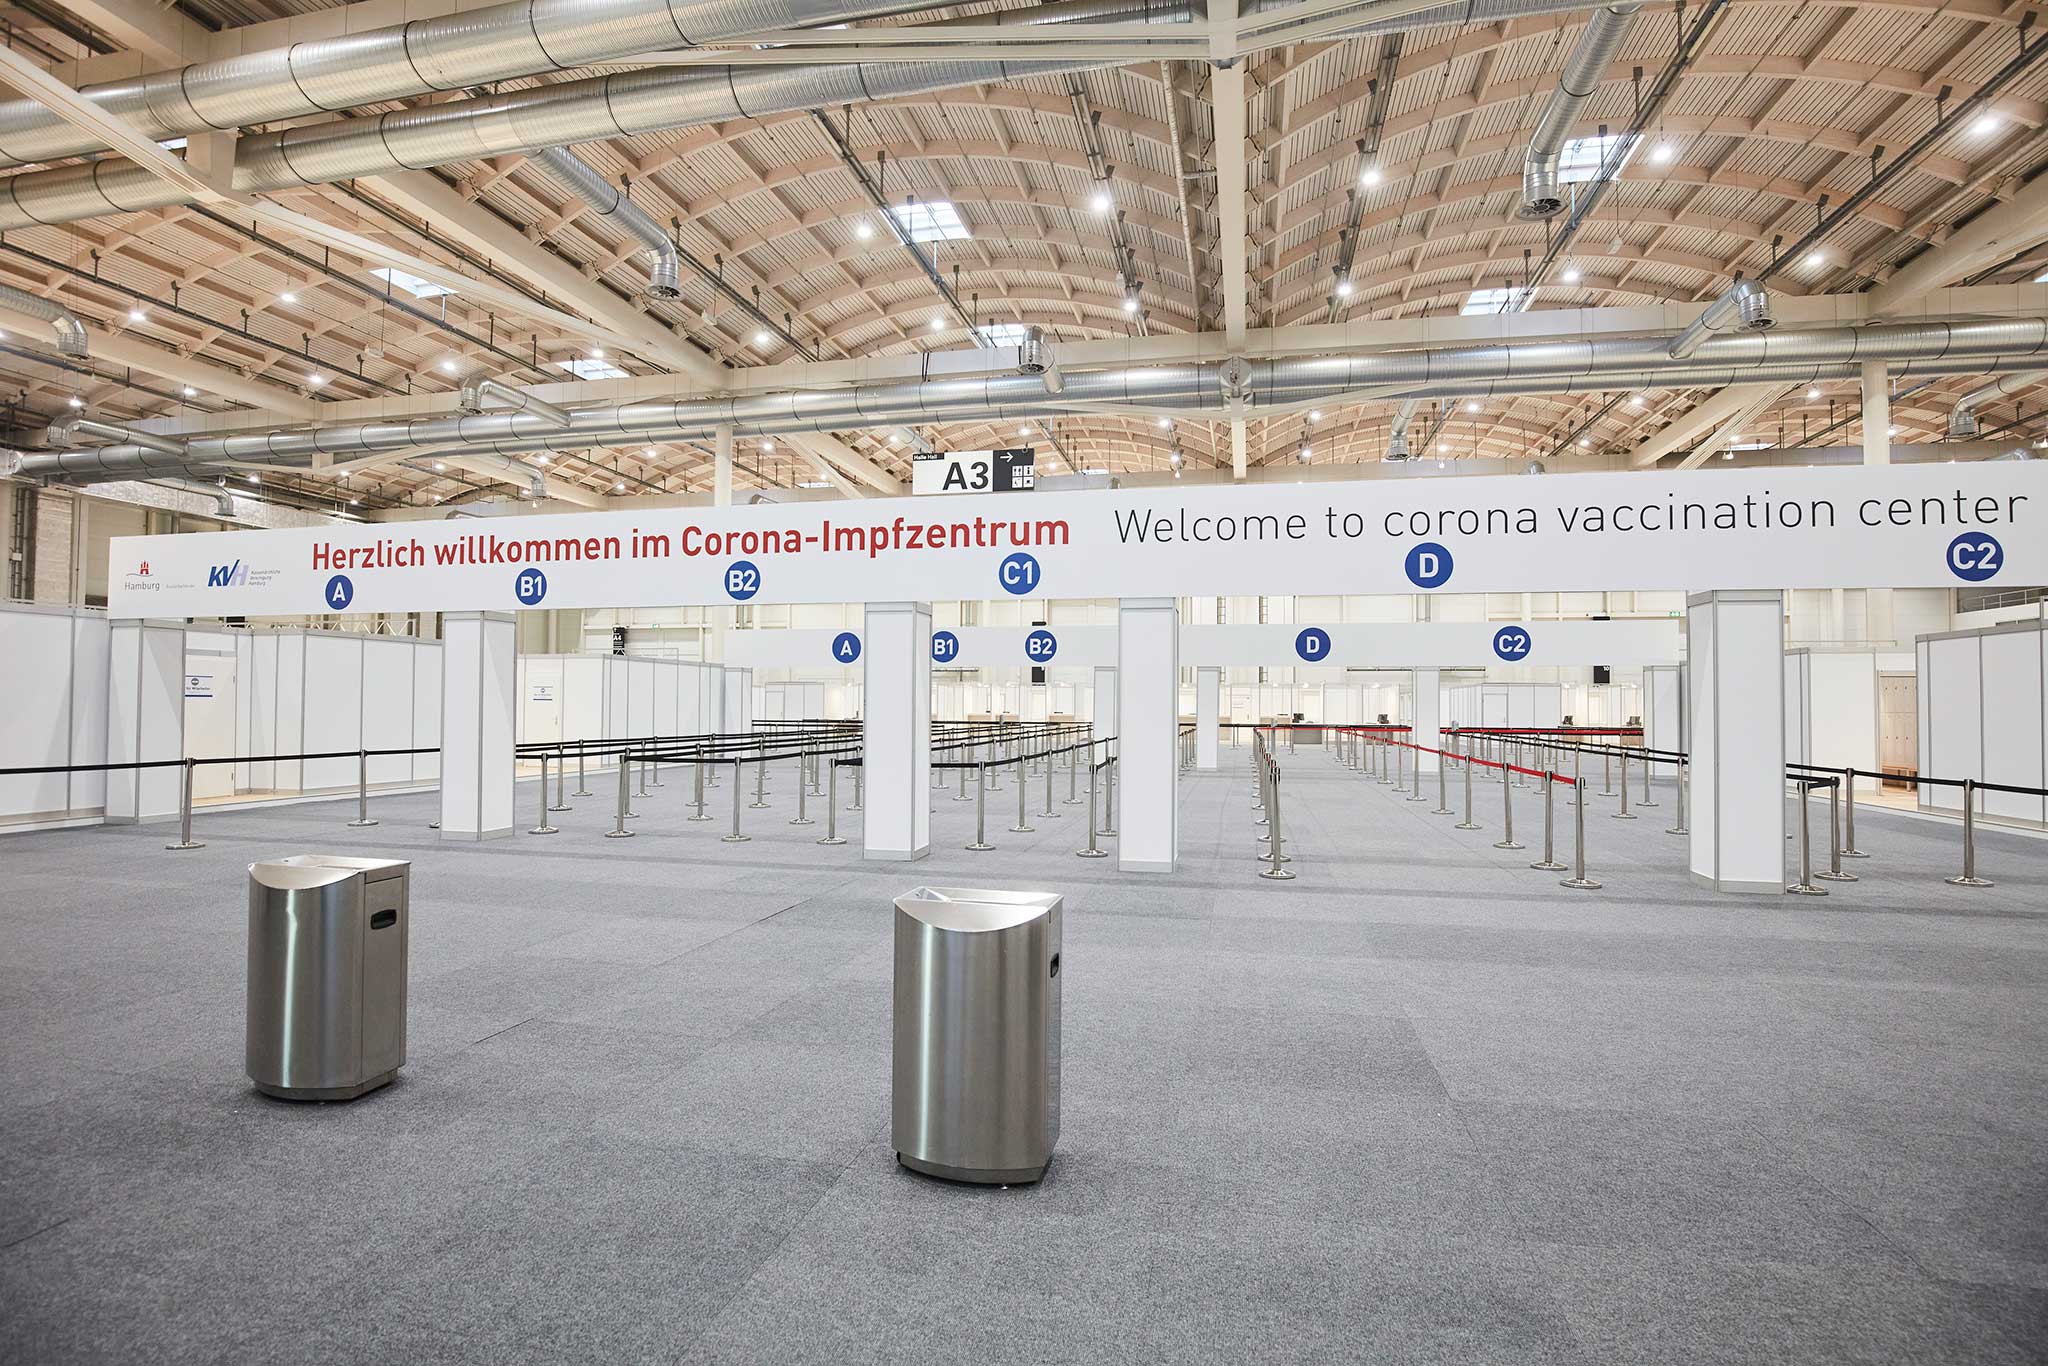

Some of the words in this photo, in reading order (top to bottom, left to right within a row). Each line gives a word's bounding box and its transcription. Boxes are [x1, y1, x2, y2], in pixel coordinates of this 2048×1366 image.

[942, 461, 989, 490] A3
[1114, 507, 1307, 544] Welcome
[1325, 506, 1364, 538] to
[1384, 508, 1537, 537] corona
[1557, 490, 1835, 533] vaccination
[1859, 489, 2029, 527] center
[312, 539, 425, 570] Herzlich
[434, 533, 621, 566] willkommen
[632, 528, 670, 558] im
[681, 516, 1069, 559] Corona-Impfzentrum
[1419, 553, 1439, 578] D
[1952, 543, 1995, 570] C2
[208, 559, 249, 587] KVH
[728, 569, 756, 592] B2
[1003, 560, 1033, 585] C1
[124, 581, 160, 592] Hamburg
[332, 582, 346, 601] A
[520, 576, 543, 597] B1
[839, 639, 853, 656] A
[934, 639, 954, 655] B1
[1029, 638, 1053, 655] B2
[1306, 637, 1320, 654] D
[1498, 634, 1526, 653] C2
